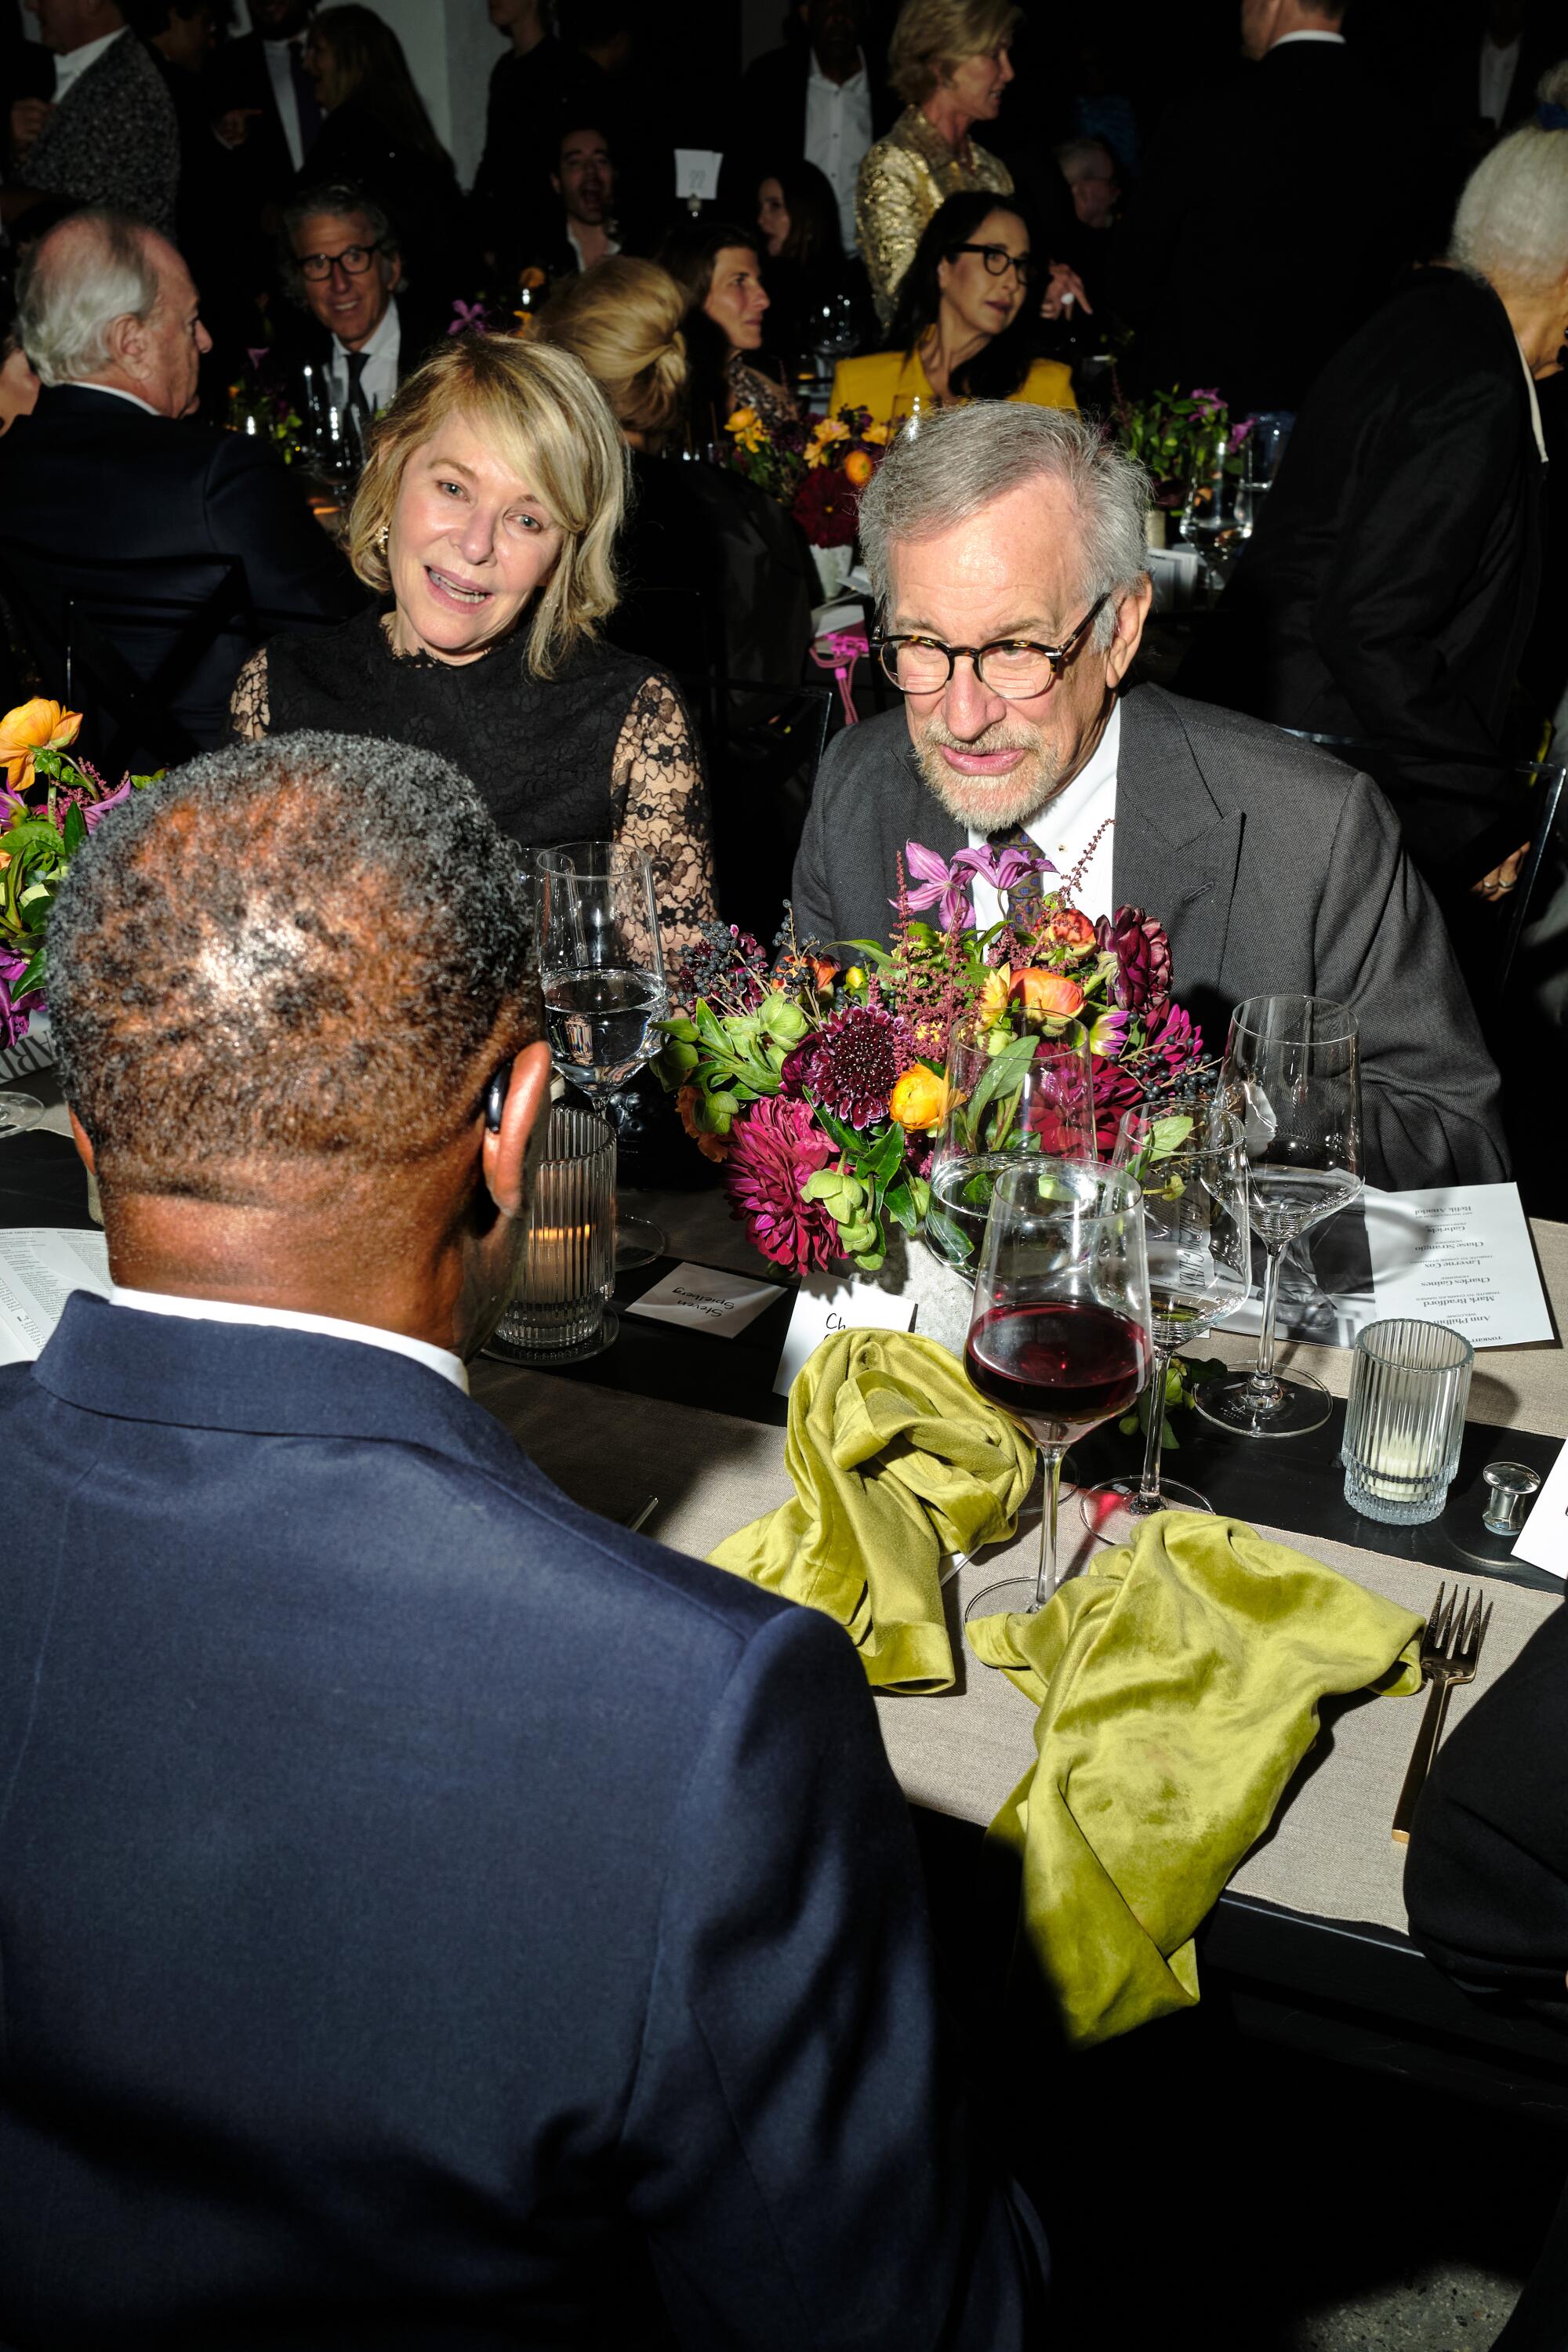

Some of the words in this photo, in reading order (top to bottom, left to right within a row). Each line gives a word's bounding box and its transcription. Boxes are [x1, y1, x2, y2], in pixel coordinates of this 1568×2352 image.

[1456, 1241, 1484, 1250] Chase
[1454, 1277, 1490, 1286] Charles
[670, 1287, 735, 1310] Spielberg
[1423, 1298, 1467, 1307] Bradford
[1469, 1296, 1494, 1305] Mark
[677, 1300, 723, 1318] Steven
